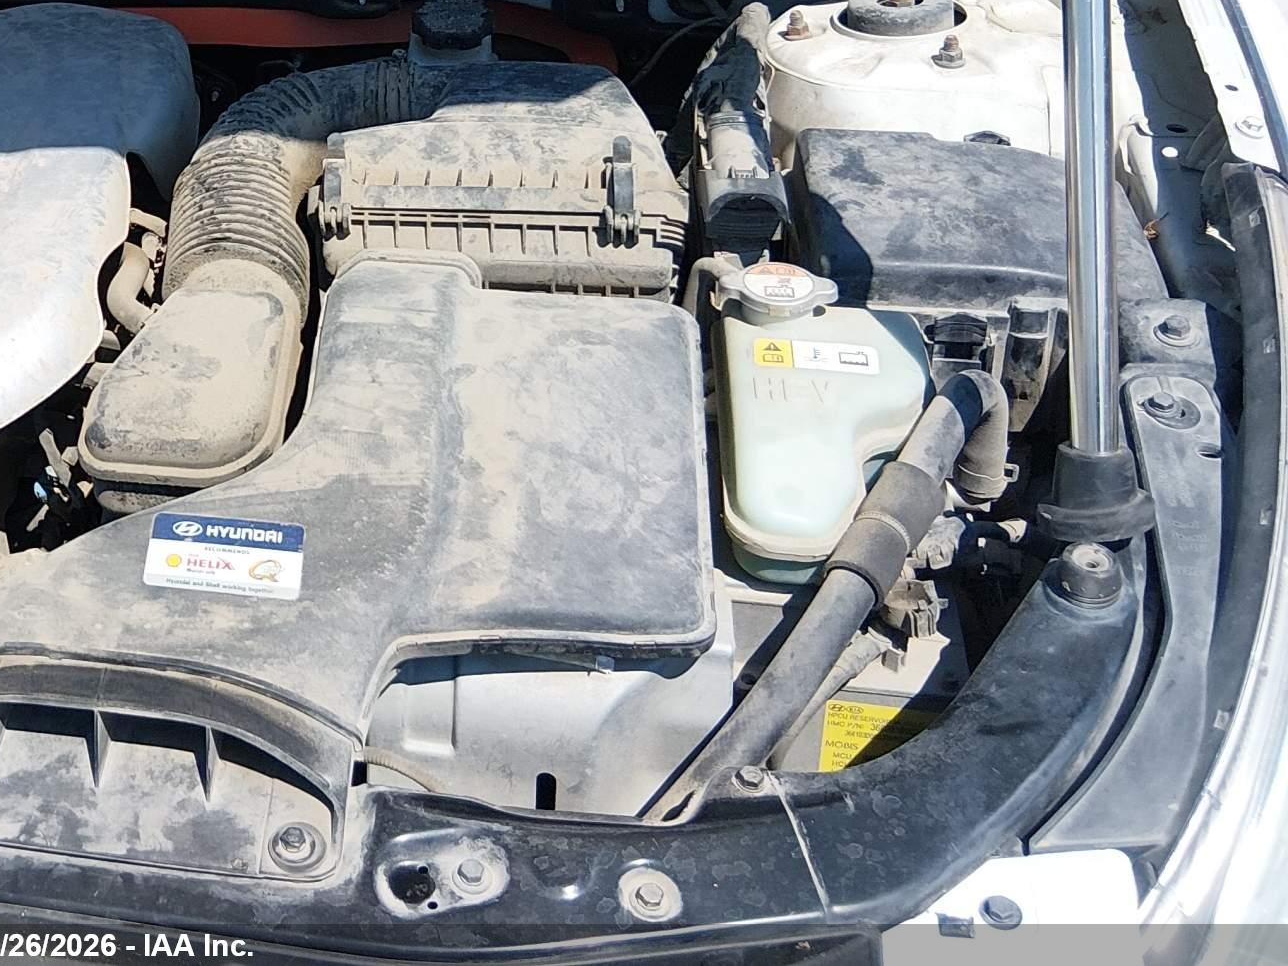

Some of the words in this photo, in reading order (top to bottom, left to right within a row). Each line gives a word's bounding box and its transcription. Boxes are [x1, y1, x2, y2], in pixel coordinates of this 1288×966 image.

[206, 525, 283, 544] HYUNDAI
[187, 557, 234, 571] HELIX
[165, 577, 191, 586] Hyundai
[222, 582, 247, 593] working
[825, 741, 859, 750] MOBIS
